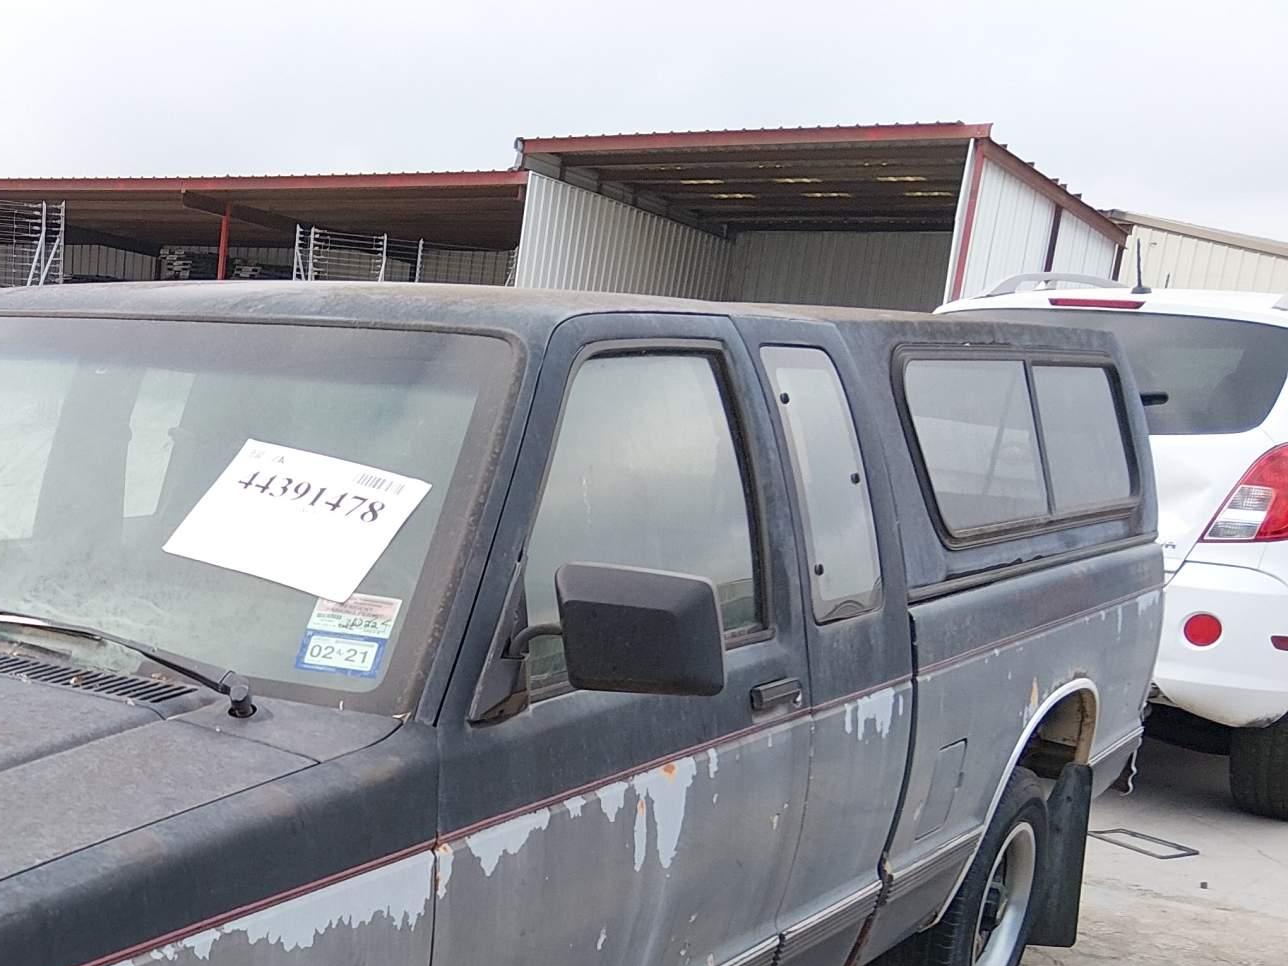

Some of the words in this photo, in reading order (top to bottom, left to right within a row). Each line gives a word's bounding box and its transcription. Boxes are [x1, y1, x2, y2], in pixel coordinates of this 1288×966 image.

[238, 471, 385, 523] 44391478
[309, 644, 335, 660] 02
[343, 648, 369, 664] 21
